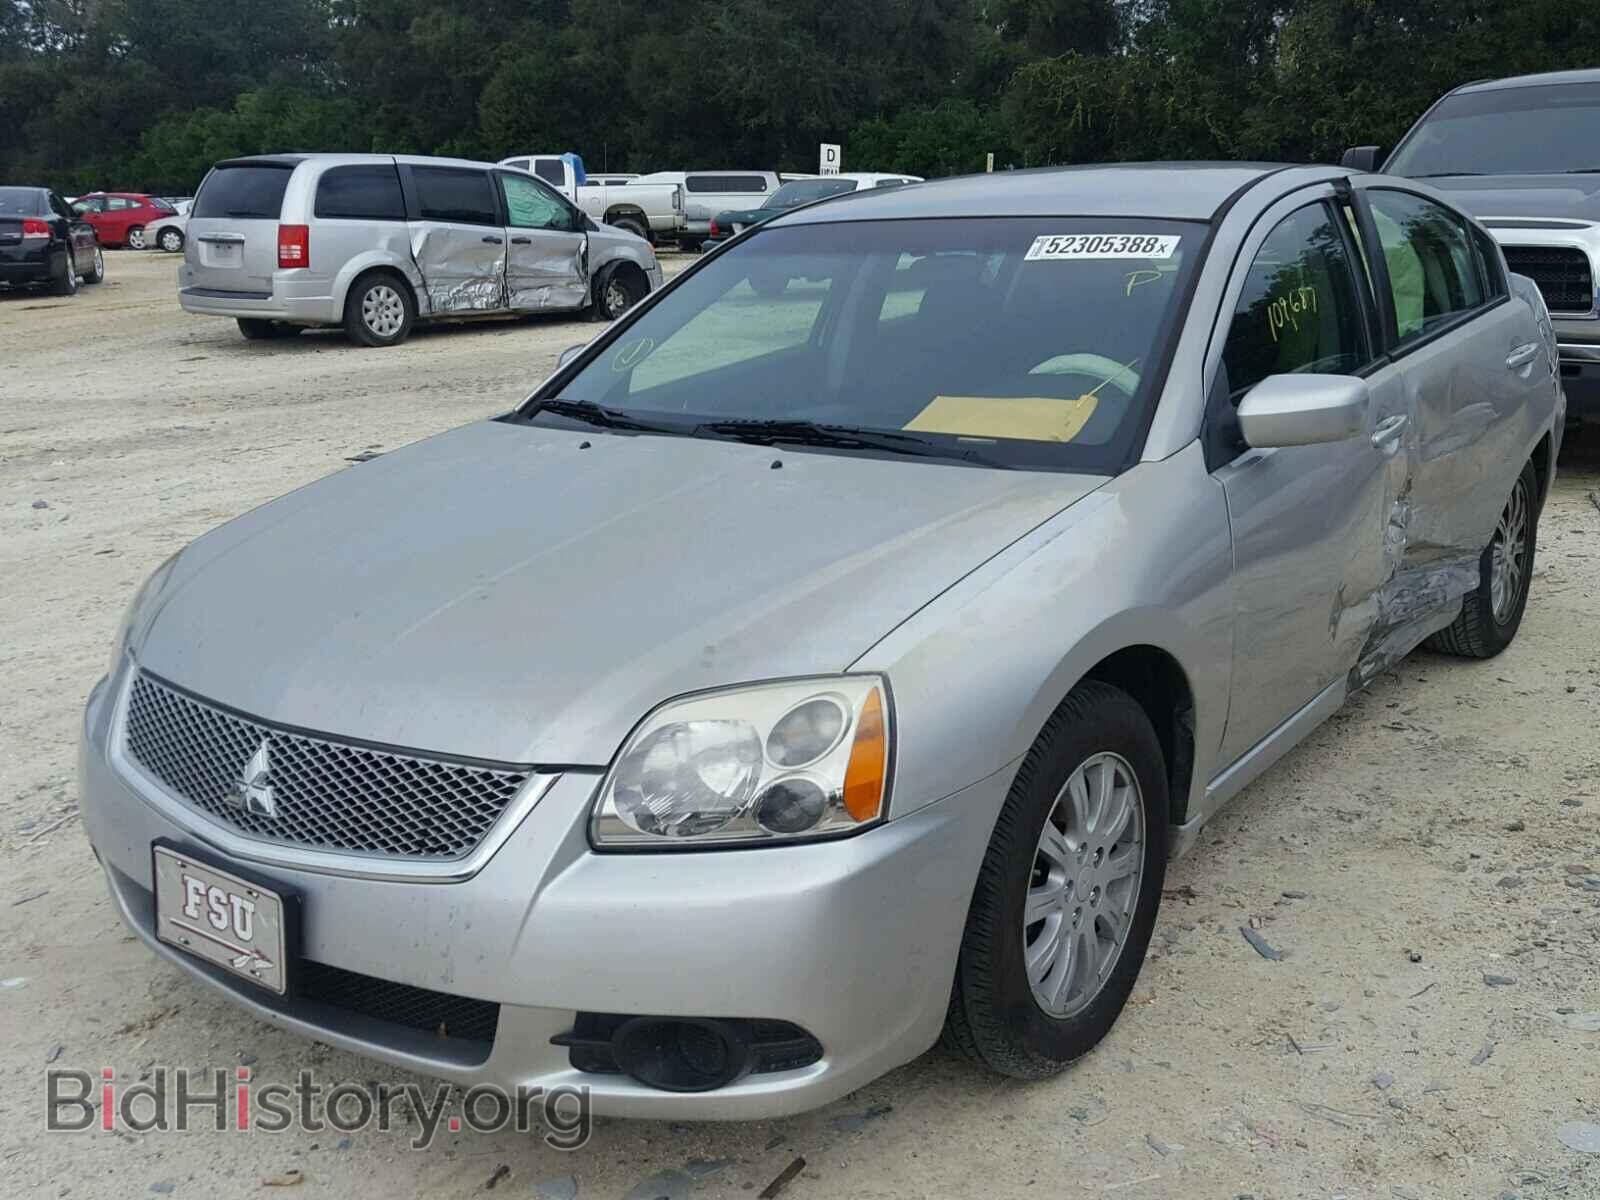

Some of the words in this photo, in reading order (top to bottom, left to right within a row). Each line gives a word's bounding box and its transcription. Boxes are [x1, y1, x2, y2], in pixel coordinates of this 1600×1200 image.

[827, 149, 835, 161] D
[1126, 270, 1162, 297] P
[182, 874, 255, 942] FSU
